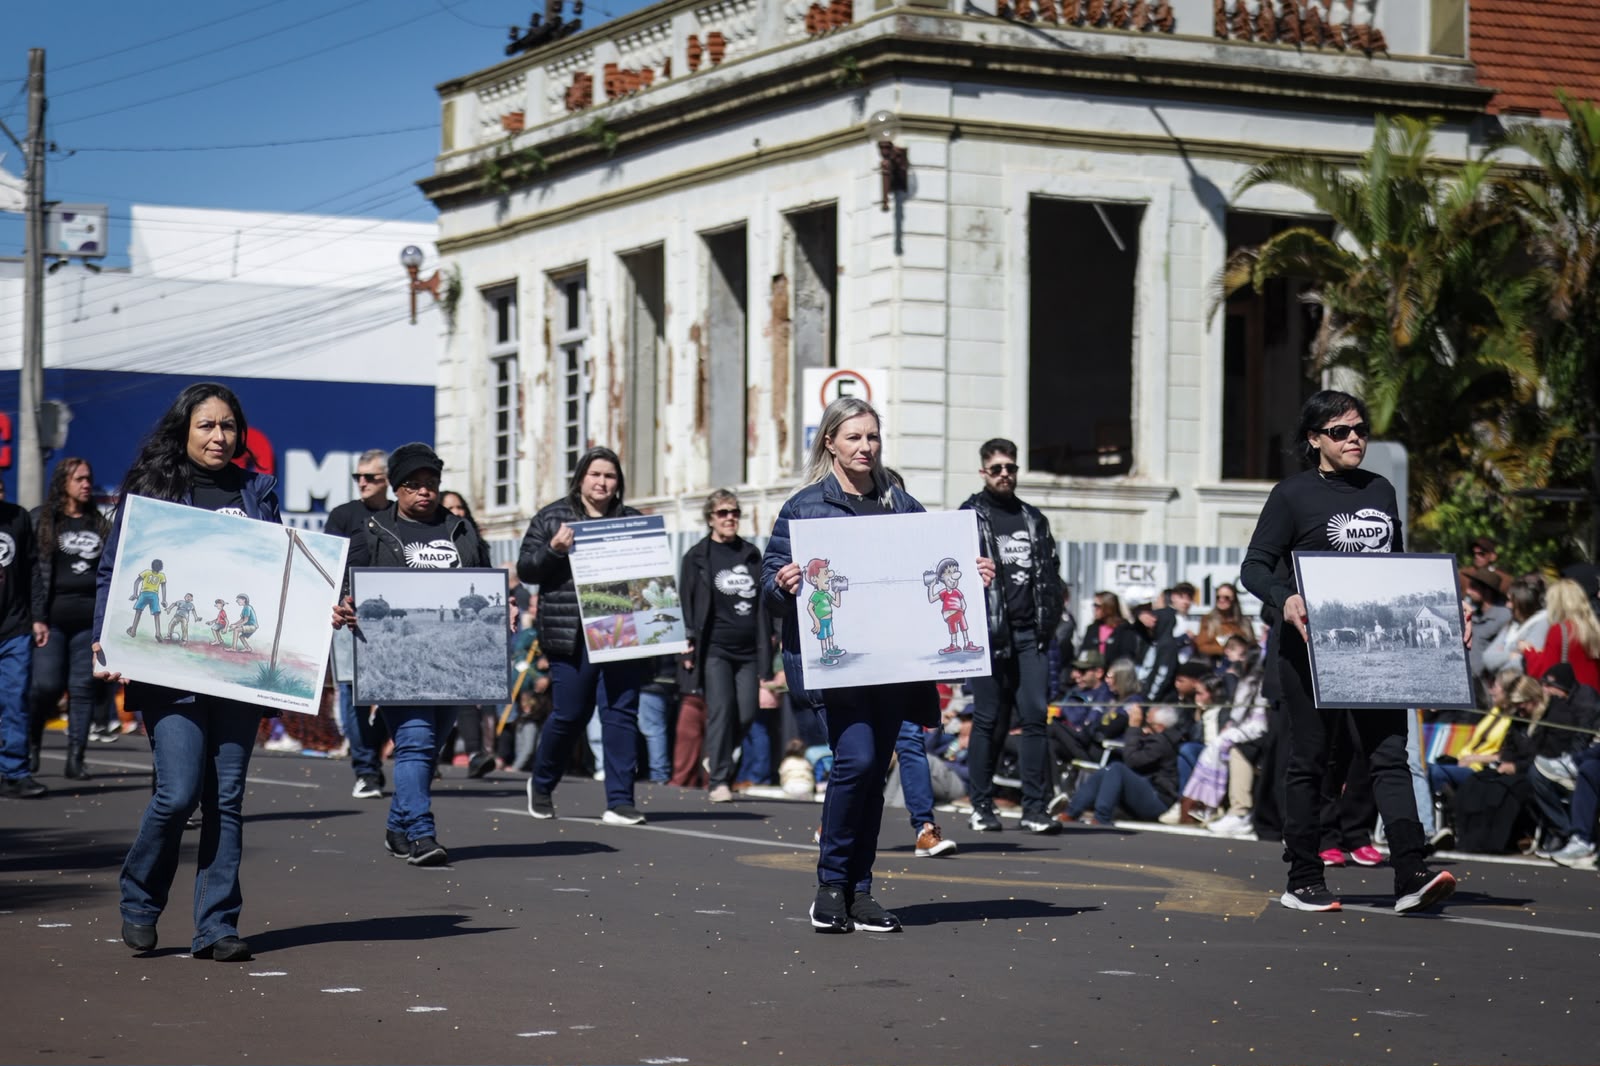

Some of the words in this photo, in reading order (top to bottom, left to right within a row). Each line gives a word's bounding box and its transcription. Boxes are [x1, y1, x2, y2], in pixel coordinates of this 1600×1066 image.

[1346, 527, 1383, 539] MADP
[419, 553, 453, 561] MADP
[1115, 564, 1157, 582] FCK
